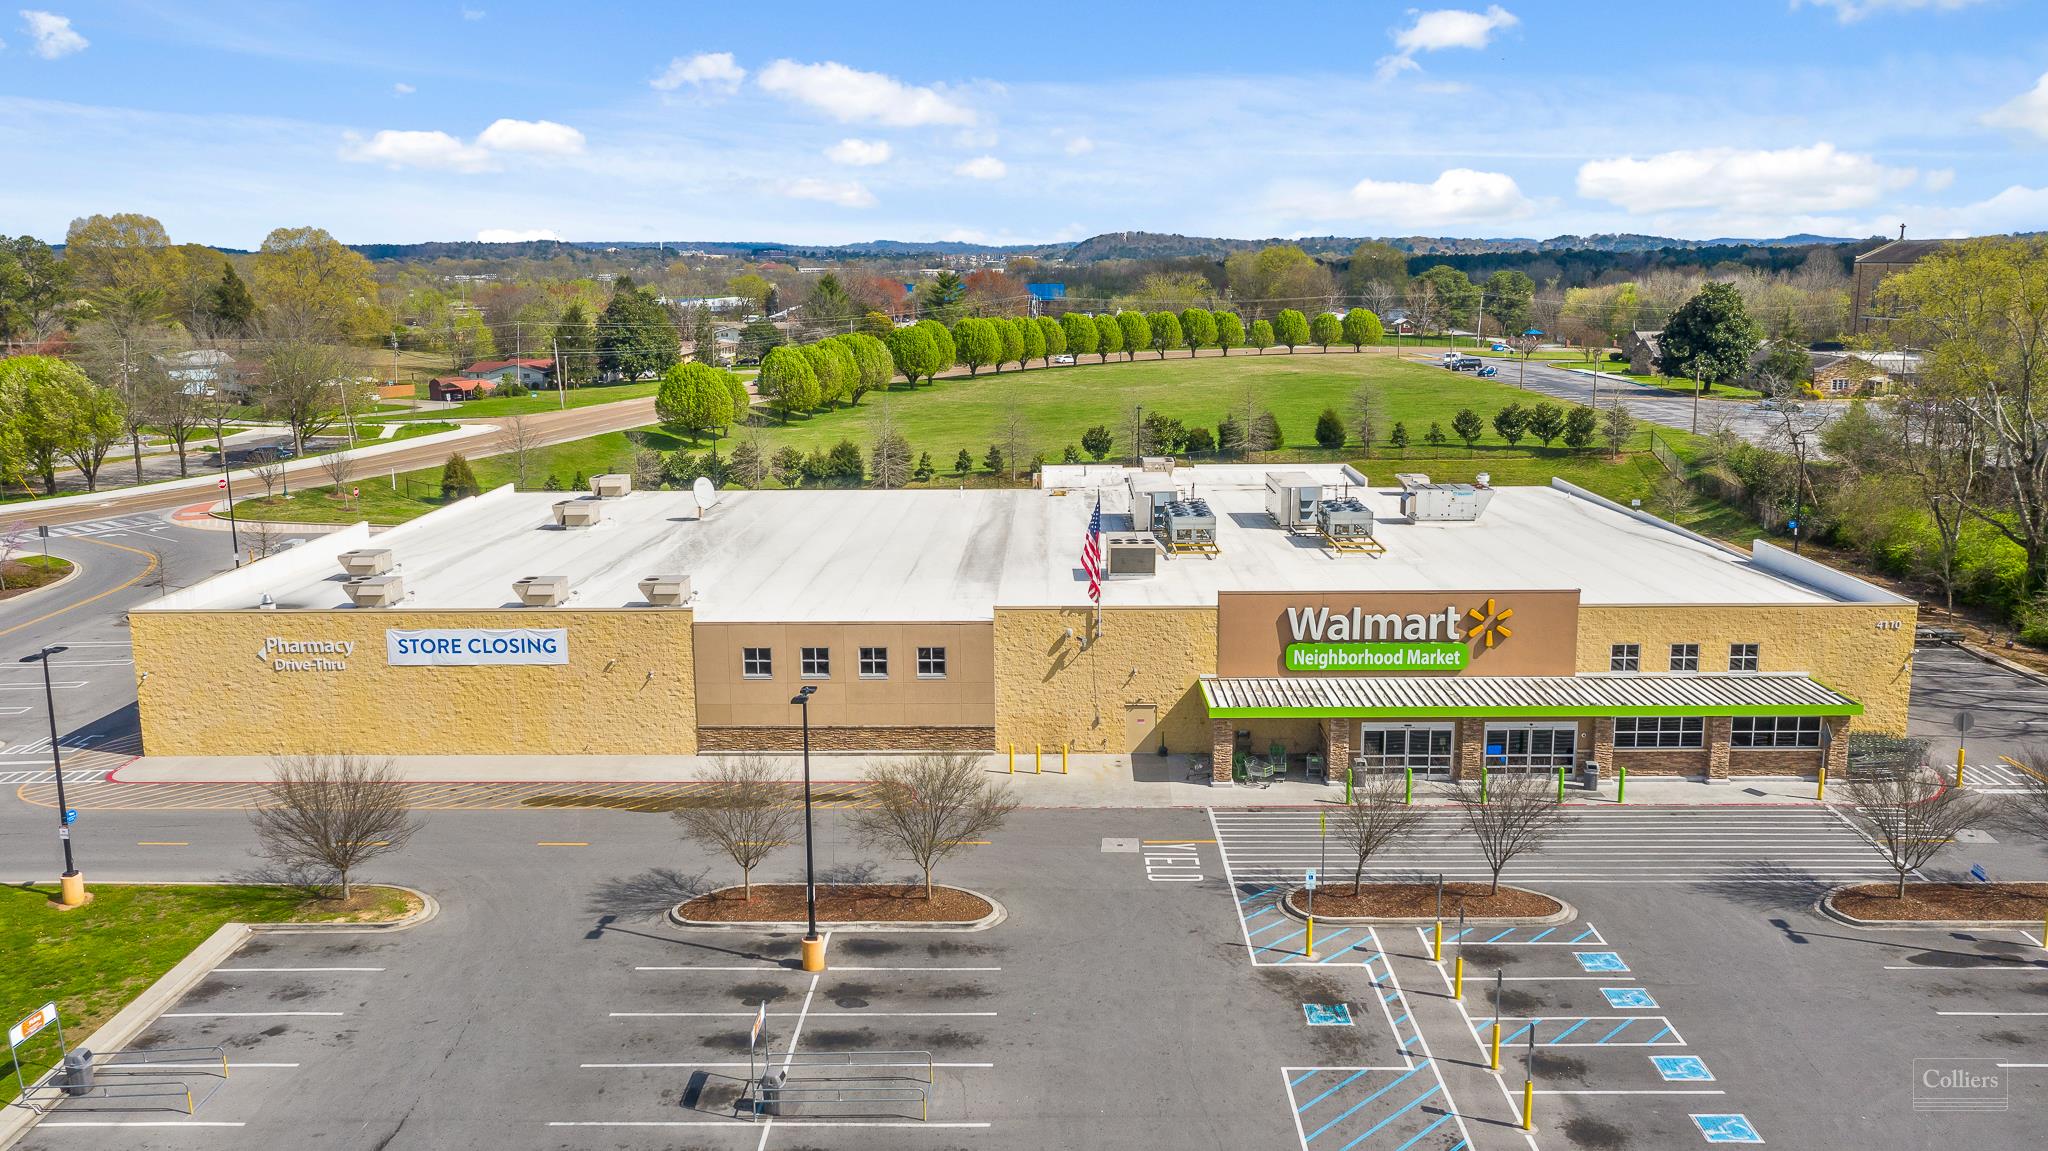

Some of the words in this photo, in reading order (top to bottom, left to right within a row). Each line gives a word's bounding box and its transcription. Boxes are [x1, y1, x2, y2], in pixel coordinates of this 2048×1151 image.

[1287, 607, 1460, 641] Walmart
[265, 637, 354, 656] Pharmacy
[399, 638, 462, 654] STORE
[468, 638, 557, 654] CLOSING
[275, 659, 346, 671] Drive-Thru
[1294, 648, 1403, 669] Neighborhood
[1407, 650, 1461, 665] Market
[1142, 843, 1204, 881] YIELD
